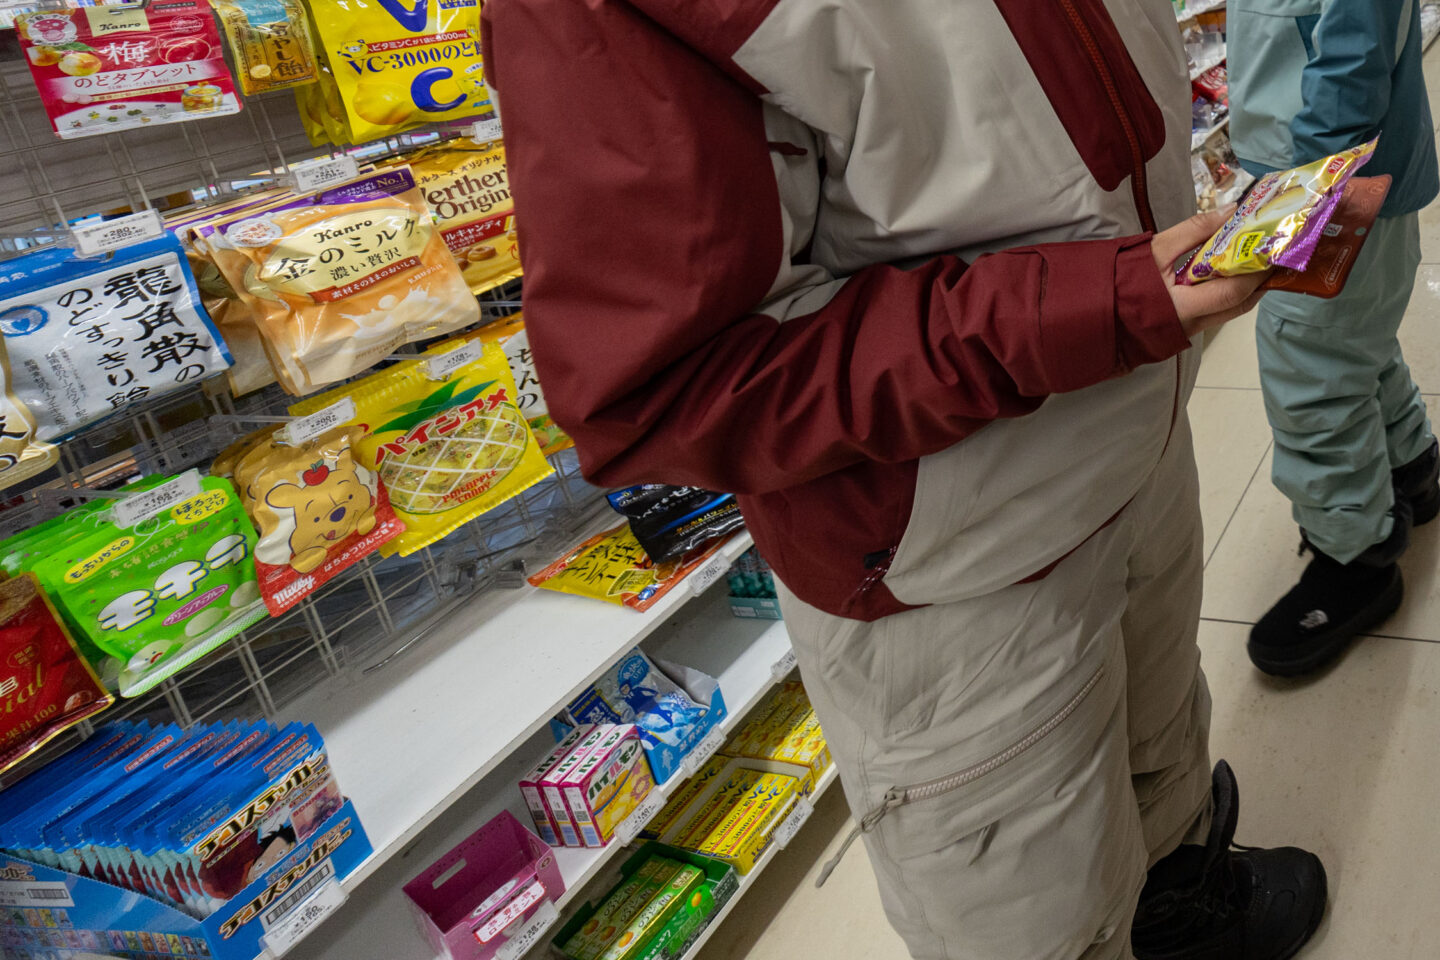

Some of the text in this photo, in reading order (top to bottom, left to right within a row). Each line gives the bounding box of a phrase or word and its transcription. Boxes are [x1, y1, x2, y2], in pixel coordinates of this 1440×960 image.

[99, 22, 141, 31] Kanro
[104, 41, 150, 66] 梅
[74, 63, 197, 89] のどタブレット
[411, 67, 467, 112] C
[376, 171, 405, 188] No.1
[435, 187, 511, 221] Origin
[313, 218, 373, 244] Kanro
[272, 217, 416, 285] 金のミルク
[329, 246, 402, 282] 濃い贅沢
[332, 257, 417, 299] 素材そのままのおいしさ
[104, 264, 211, 383] 龍角散の
[57, 288, 150, 411] のどすっきり飴
[374, 387, 510, 466] パインアメ
[175, 492, 221, 516] ほろっと
[442, 468, 498, 504] PINEAPPLE
[184, 498, 227, 521] くちどけ
[70, 539, 130, 580] もっちりからの
[271, 574, 316, 606] Milky
[0, 662, 44, 713] ial
